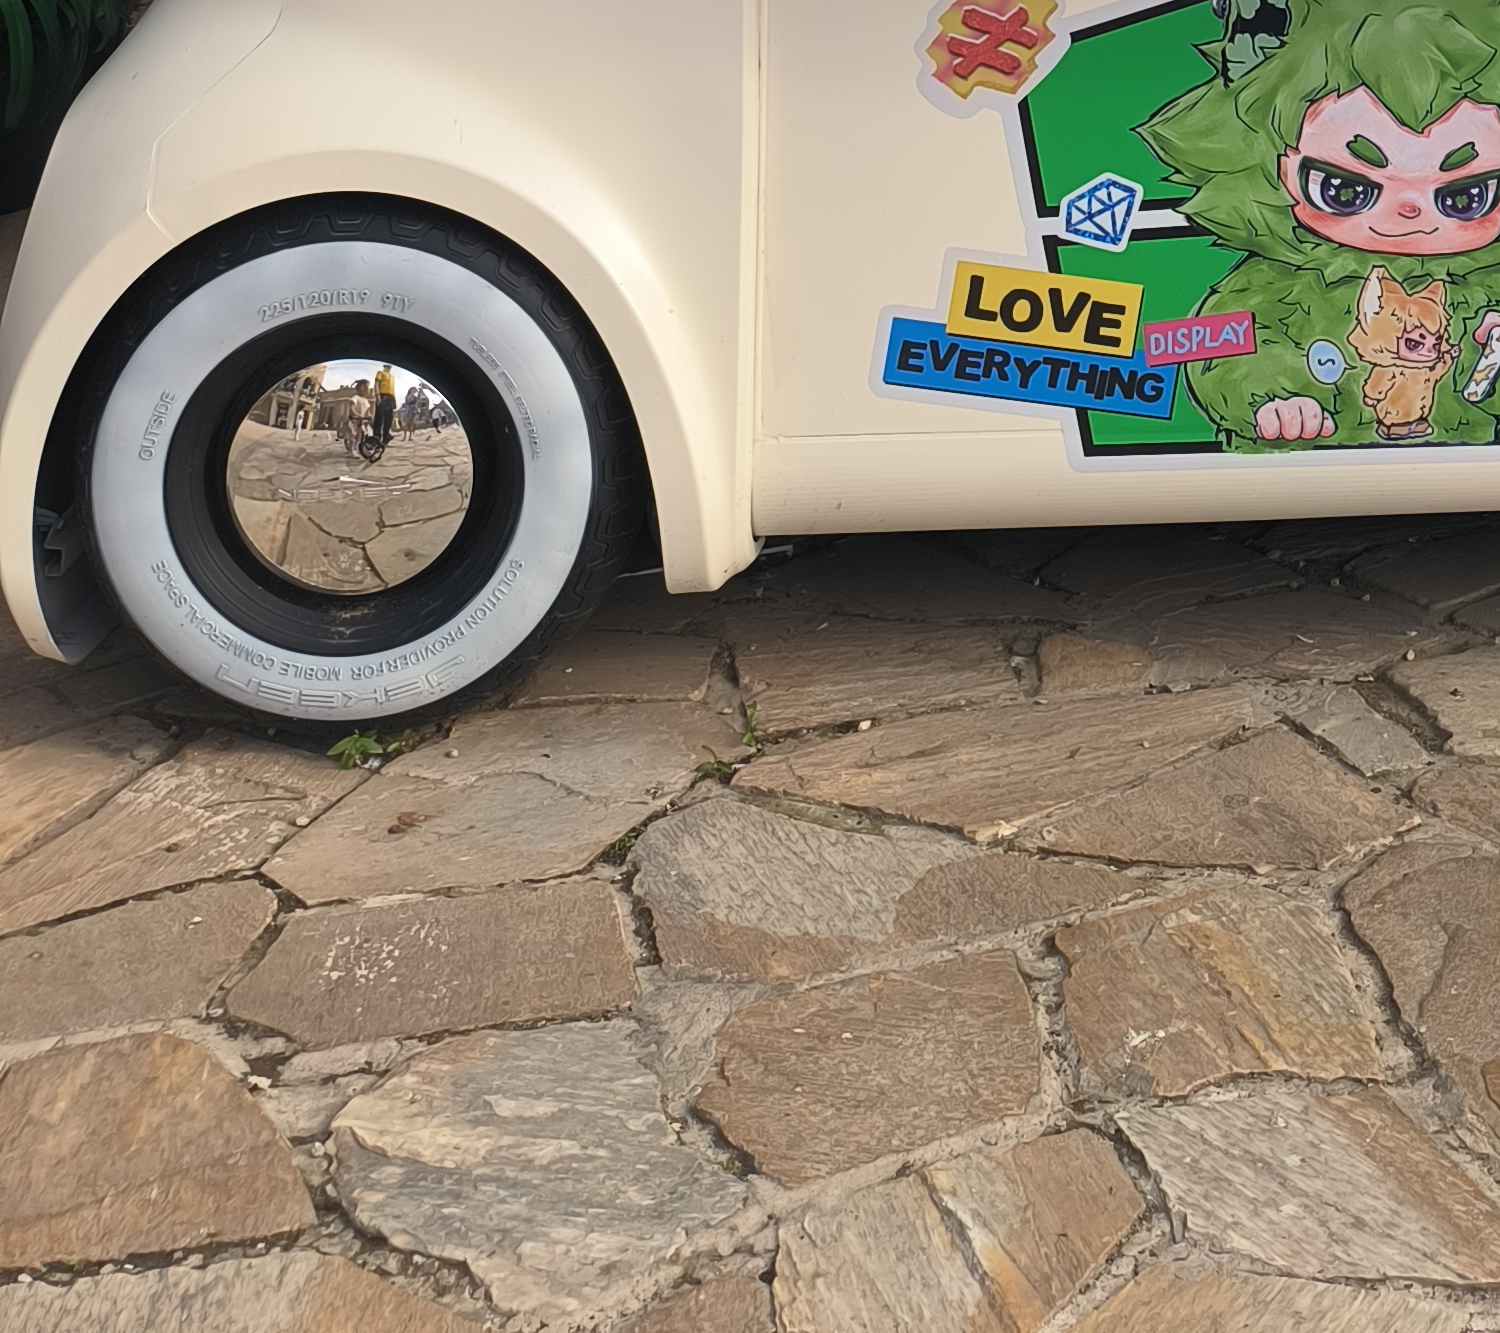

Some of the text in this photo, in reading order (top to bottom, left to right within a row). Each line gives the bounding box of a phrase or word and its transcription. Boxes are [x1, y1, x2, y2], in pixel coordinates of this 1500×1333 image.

[258, 288, 371, 323] 225/120/R19
[964, 275, 1127, 348] LOVE
[1149, 319, 1250, 356] DISPLAY
[897, 341, 1167, 405] EVERYTHING
[139, 390, 178, 461] OUTSIDE
[151, 560, 525, 682] SOLUTION PROVIDER FOR MOBILE COMMERCIAL SPACE
